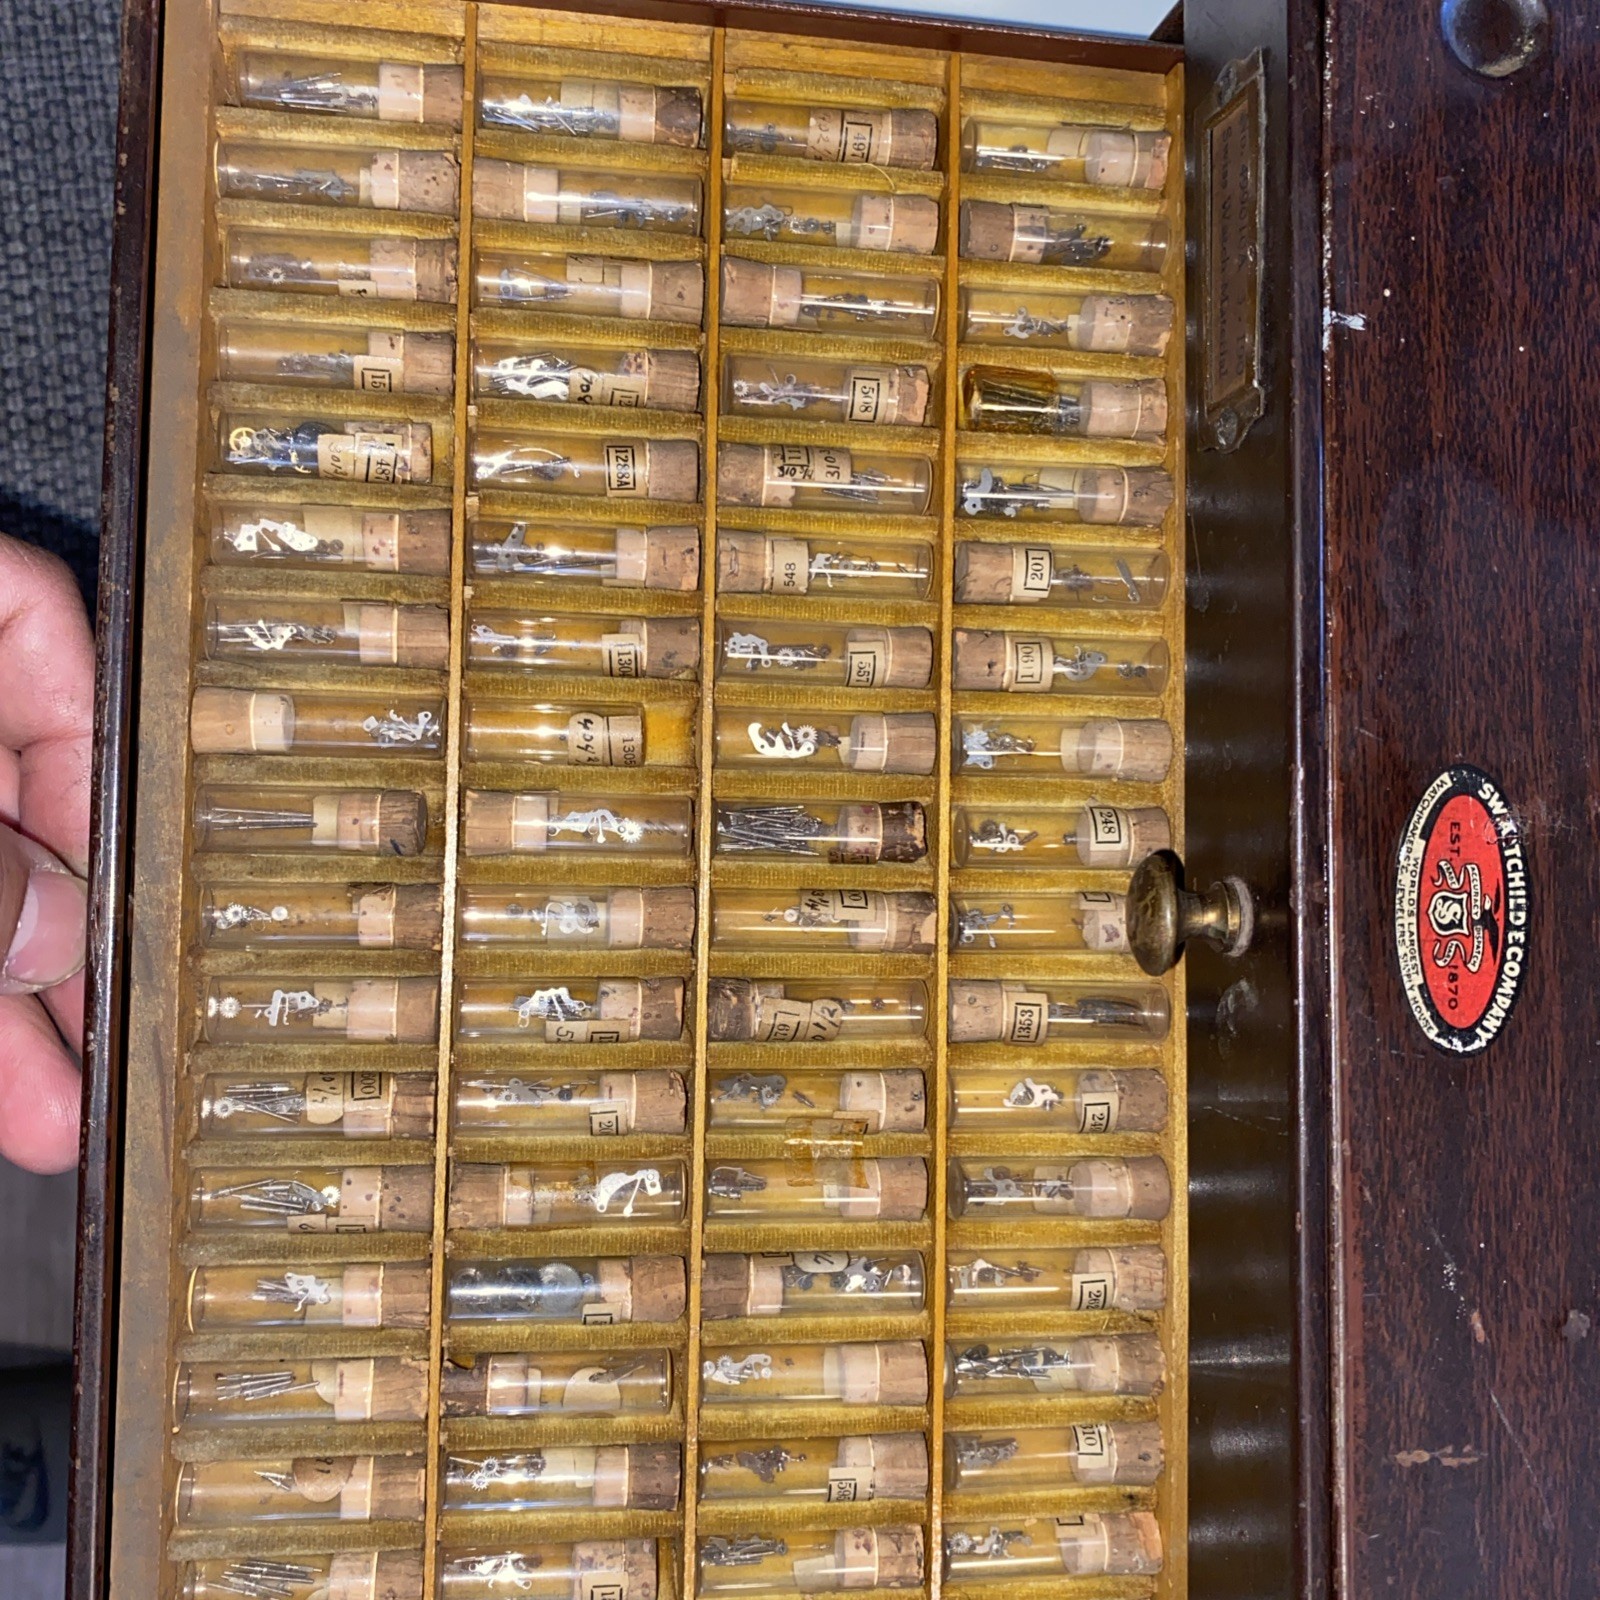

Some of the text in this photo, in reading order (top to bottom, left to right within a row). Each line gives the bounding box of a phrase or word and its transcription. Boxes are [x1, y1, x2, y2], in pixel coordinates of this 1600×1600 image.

[850, 131, 867, 158] 497
[859, 385, 876, 414] 508
[615, 449, 632, 488] 1288A
[784, 563, 797, 589] 548
[1030, 556, 1045, 581] 201
[855, 661, 872, 683] 557
[1099, 811, 1117, 835] 248
[1407, 857, 1420, 976] WORLD'S LARGEST
[1469, 866, 1484, 967] ACCURACY DISPATCH
[1447, 965, 1459, 1010] 1870
[1475, 946, 1524, 1043] COMPANY
[1016, 1009, 1034, 1040] 1353
[1410, 996, 1435, 1035] HOUSE
[1085, 1290, 1103, 1310] 262
